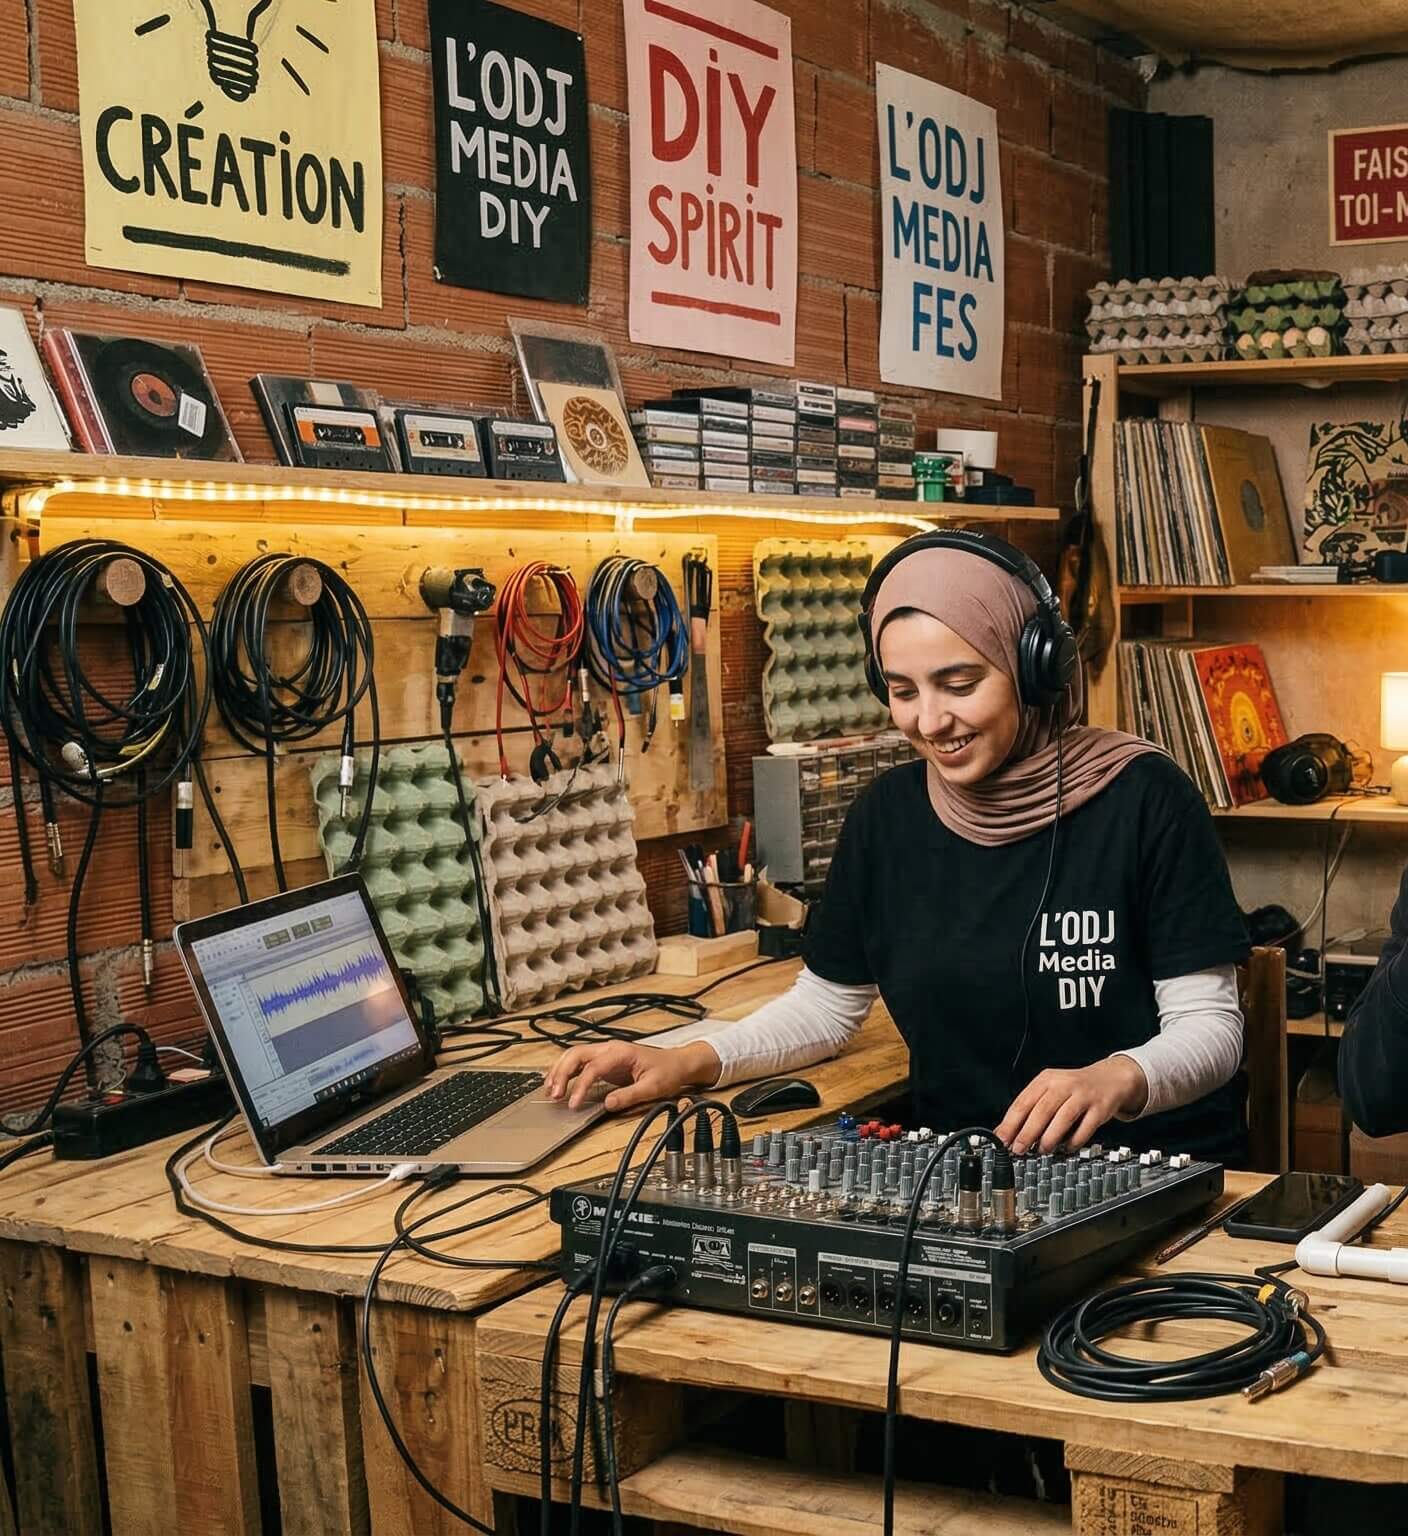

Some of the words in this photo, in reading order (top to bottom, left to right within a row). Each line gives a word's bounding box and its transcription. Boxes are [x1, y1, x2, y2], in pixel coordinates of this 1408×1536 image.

[446, 37, 573, 137] L'ODJ
[449, 120, 578, 202] MEDIA
[887, 104, 986, 205] L'ODJ
[478, 191, 551, 248] DIY
[892, 195, 995, 282] MEDIA
[912, 280, 979, 362] FES
[1038, 949, 1116, 973] Media
[1039, 910, 1115, 947] L'ODJ
[1058, 975, 1106, 1010] DIY
